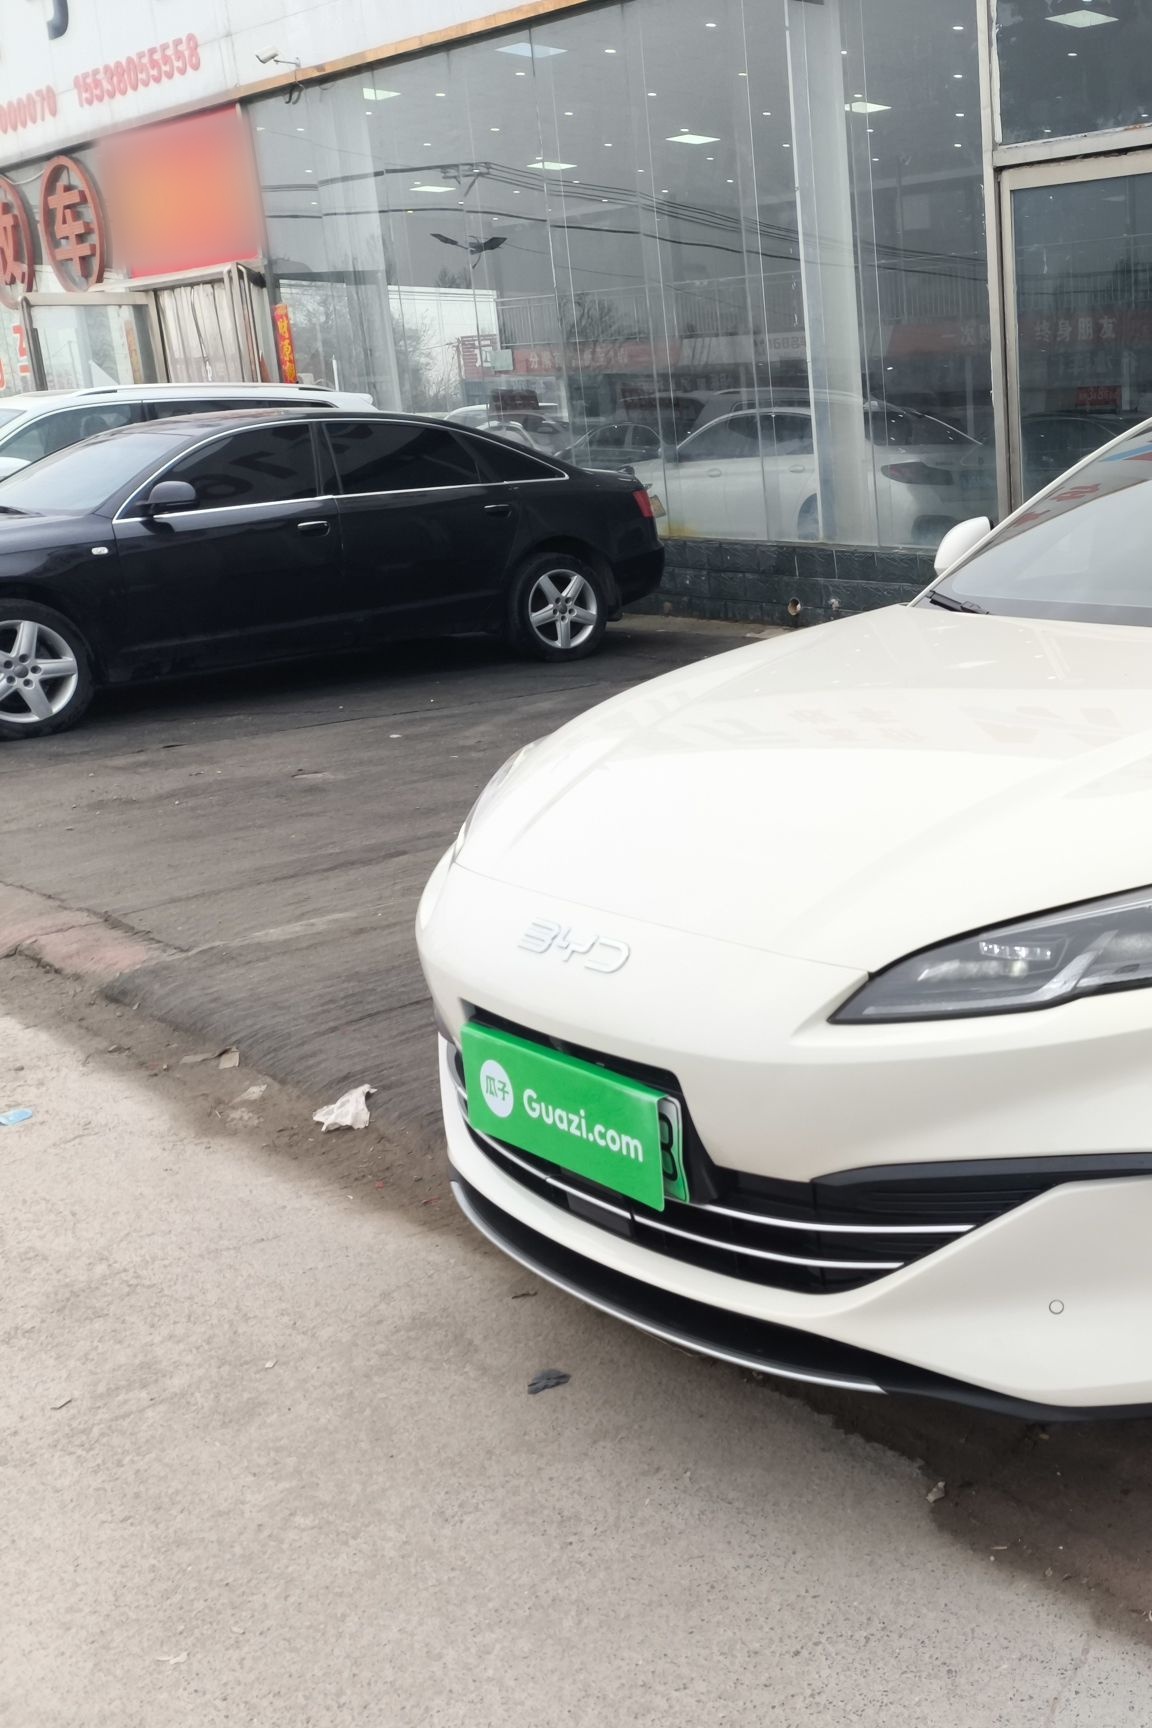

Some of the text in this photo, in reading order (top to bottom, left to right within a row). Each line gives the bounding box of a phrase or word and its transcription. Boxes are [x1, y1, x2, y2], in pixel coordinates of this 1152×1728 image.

[73, 33, 200, 107] 15538055558
[517, 917, 631, 974] BYD
[485, 1075, 509, 1102] 瓜子
[523, 1088, 643, 1162] Guazi.com
